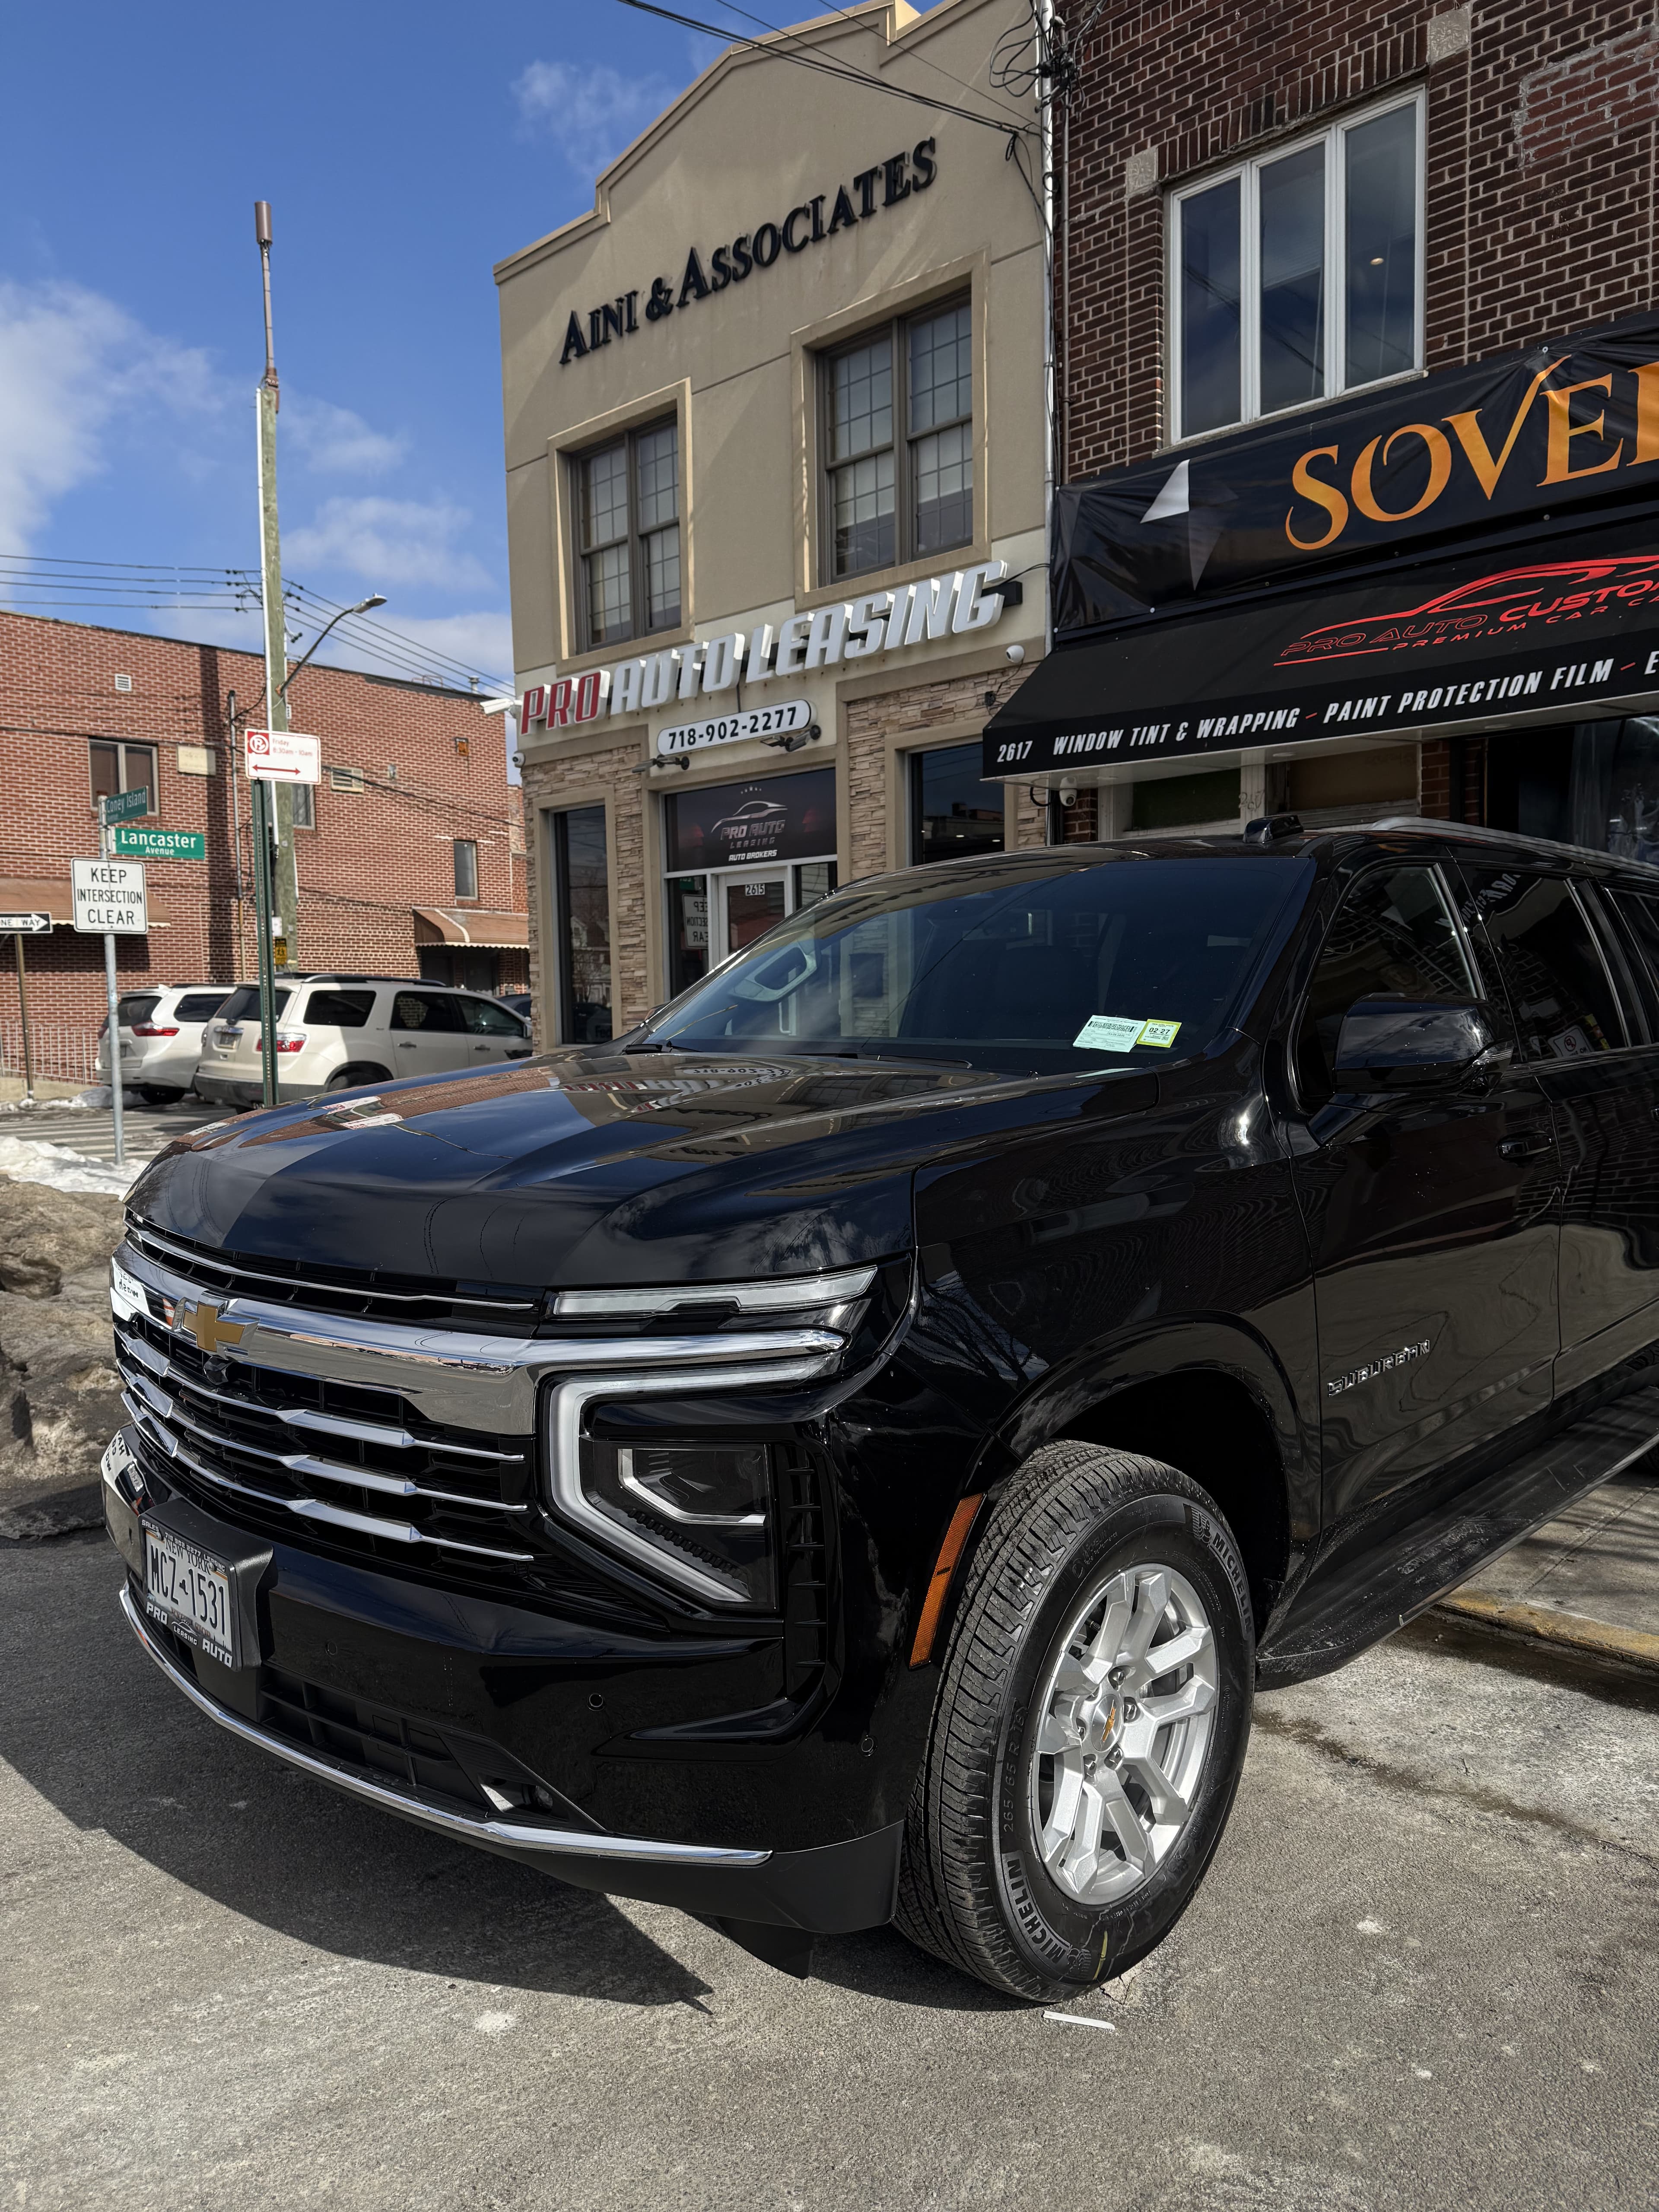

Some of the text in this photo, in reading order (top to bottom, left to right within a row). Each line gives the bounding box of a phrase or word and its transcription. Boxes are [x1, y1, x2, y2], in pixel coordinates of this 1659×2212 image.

[559, 136, 938, 364] AINI & ASSOCIATES
[1281, 580, 1659, 656] PRO AUTO CUSTO
[1393, 622, 1526, 650] PREMIUM
[1546, 606, 1608, 623] CAR
[521, 560, 1007, 735] PRO AUTO LEASING
[668, 706, 797, 750] 718-902-2277
[997, 741, 1033, 763] 2617
[1053, 730, 1124, 755] WINDOW
[1129, 724, 1171, 746] TINT
[1176, 722, 1188, 741] &
[1197, 707, 1300, 739] WRAPPING
[1323, 695, 1391, 724] PAINT
[1397, 671, 1543, 714] PROTECTION
[1550, 658, 1614, 691] FILM
[107, 788, 146, 813] Coney Island
[121, 830, 196, 849] Lancaster
[720, 820, 785, 840] PRO AUTO
[730, 837, 775, 849] LEASING
[145, 846, 175, 855] Avenue
[746, 850, 777, 859] BROKERS
[77, 888, 142, 904] INTERSECTION
[91, 868, 127, 884] KEEP
[747, 884, 764, 895] 2615
[88, 909, 134, 925] CLEAR
[1327, 1339, 1430, 1398] SUBURBAN
[142, 1519, 226, 1572] SALES 718 902 2277 LEASING
[165, 1539, 211, 1575] NEW YORK
[1212, 1532, 1252, 1634] MICHELIN
[146, 1602, 168, 1625] PRO
[202, 1638, 232, 1668] AUTO
[174, 1626, 197, 1646] LEASING
[1004, 1762, 1016, 1832] 265/65
[1007, 1859, 1066, 1964] MICHELIN
